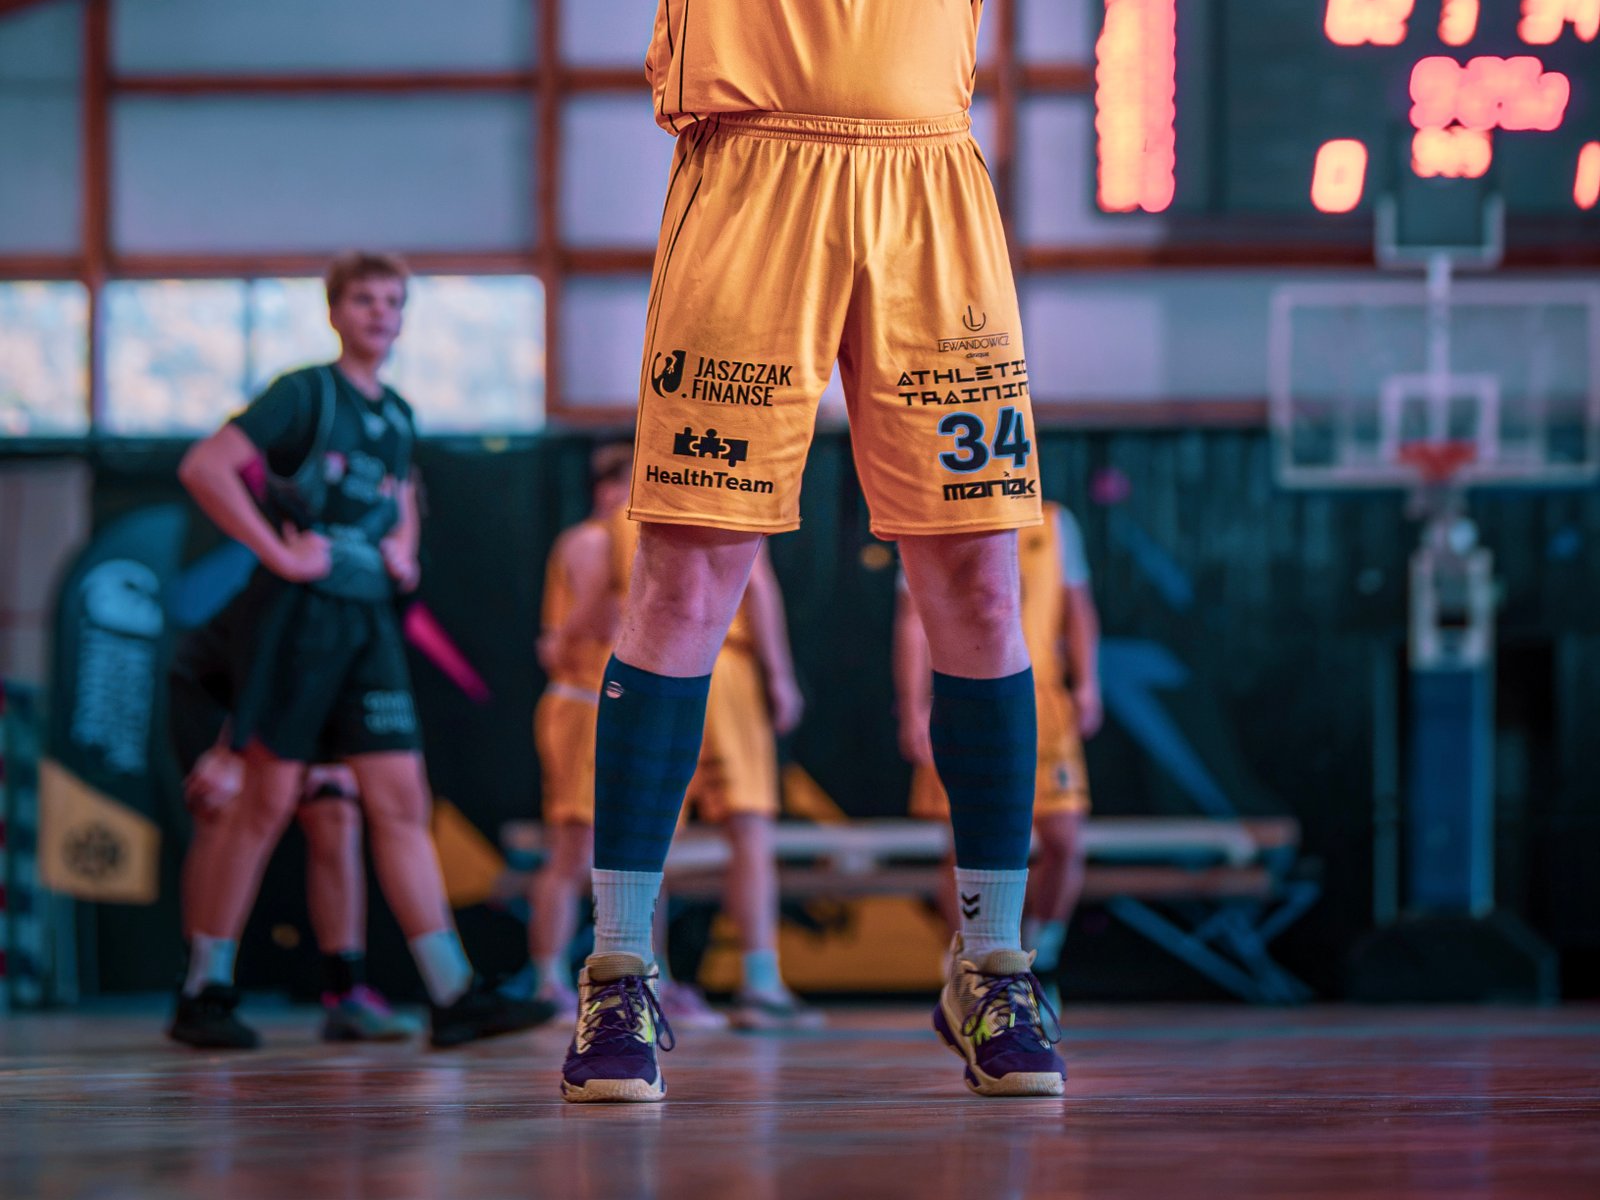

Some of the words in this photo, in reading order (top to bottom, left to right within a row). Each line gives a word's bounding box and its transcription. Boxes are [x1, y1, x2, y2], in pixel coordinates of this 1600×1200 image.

[938, 335, 1011, 354] LEWANDOWICZ
[694, 356, 793, 387] JASZCZAK
[896, 359, 1027, 387] ATHLETI
[691, 379, 775, 407] FINANSE
[937, 406, 1031, 474] 34
[646, 464, 774, 494] HealthTeam
